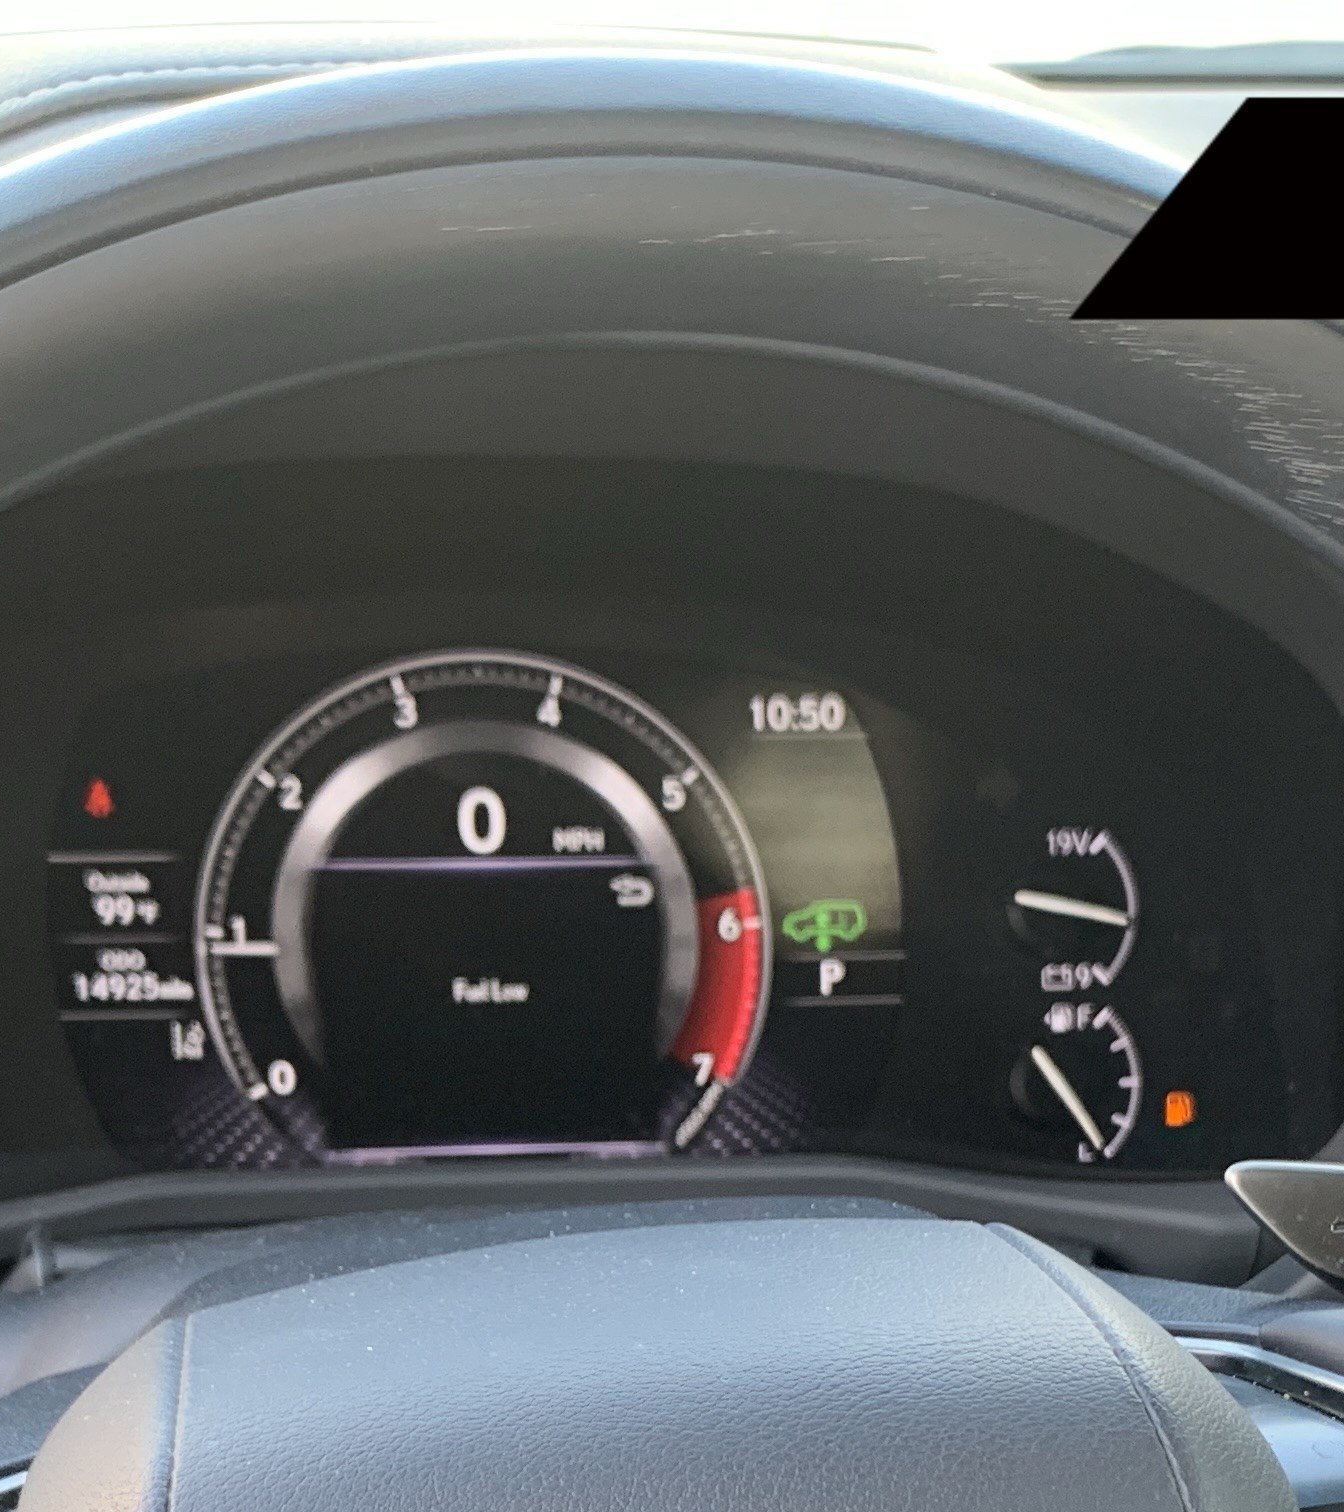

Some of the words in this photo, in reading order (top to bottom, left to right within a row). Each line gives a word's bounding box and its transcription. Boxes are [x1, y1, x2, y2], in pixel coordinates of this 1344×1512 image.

[395, 698, 418, 728] 3
[537, 697, 561, 727] 4
[750, 692, 846, 733] 10:50
[278, 777, 303, 810] 2
[662, 778, 687, 810] 5
[456, 785, 507, 855] 0
[1047, 828, 1092, 857] 19V
[93, 893, 135, 926] 99
[718, 908, 742, 941] 6
[231, 915, 247, 946] 1
[819, 958, 846, 997] P
[268, 1060, 298, 1096] 0
[693, 1052, 714, 1087] 7
